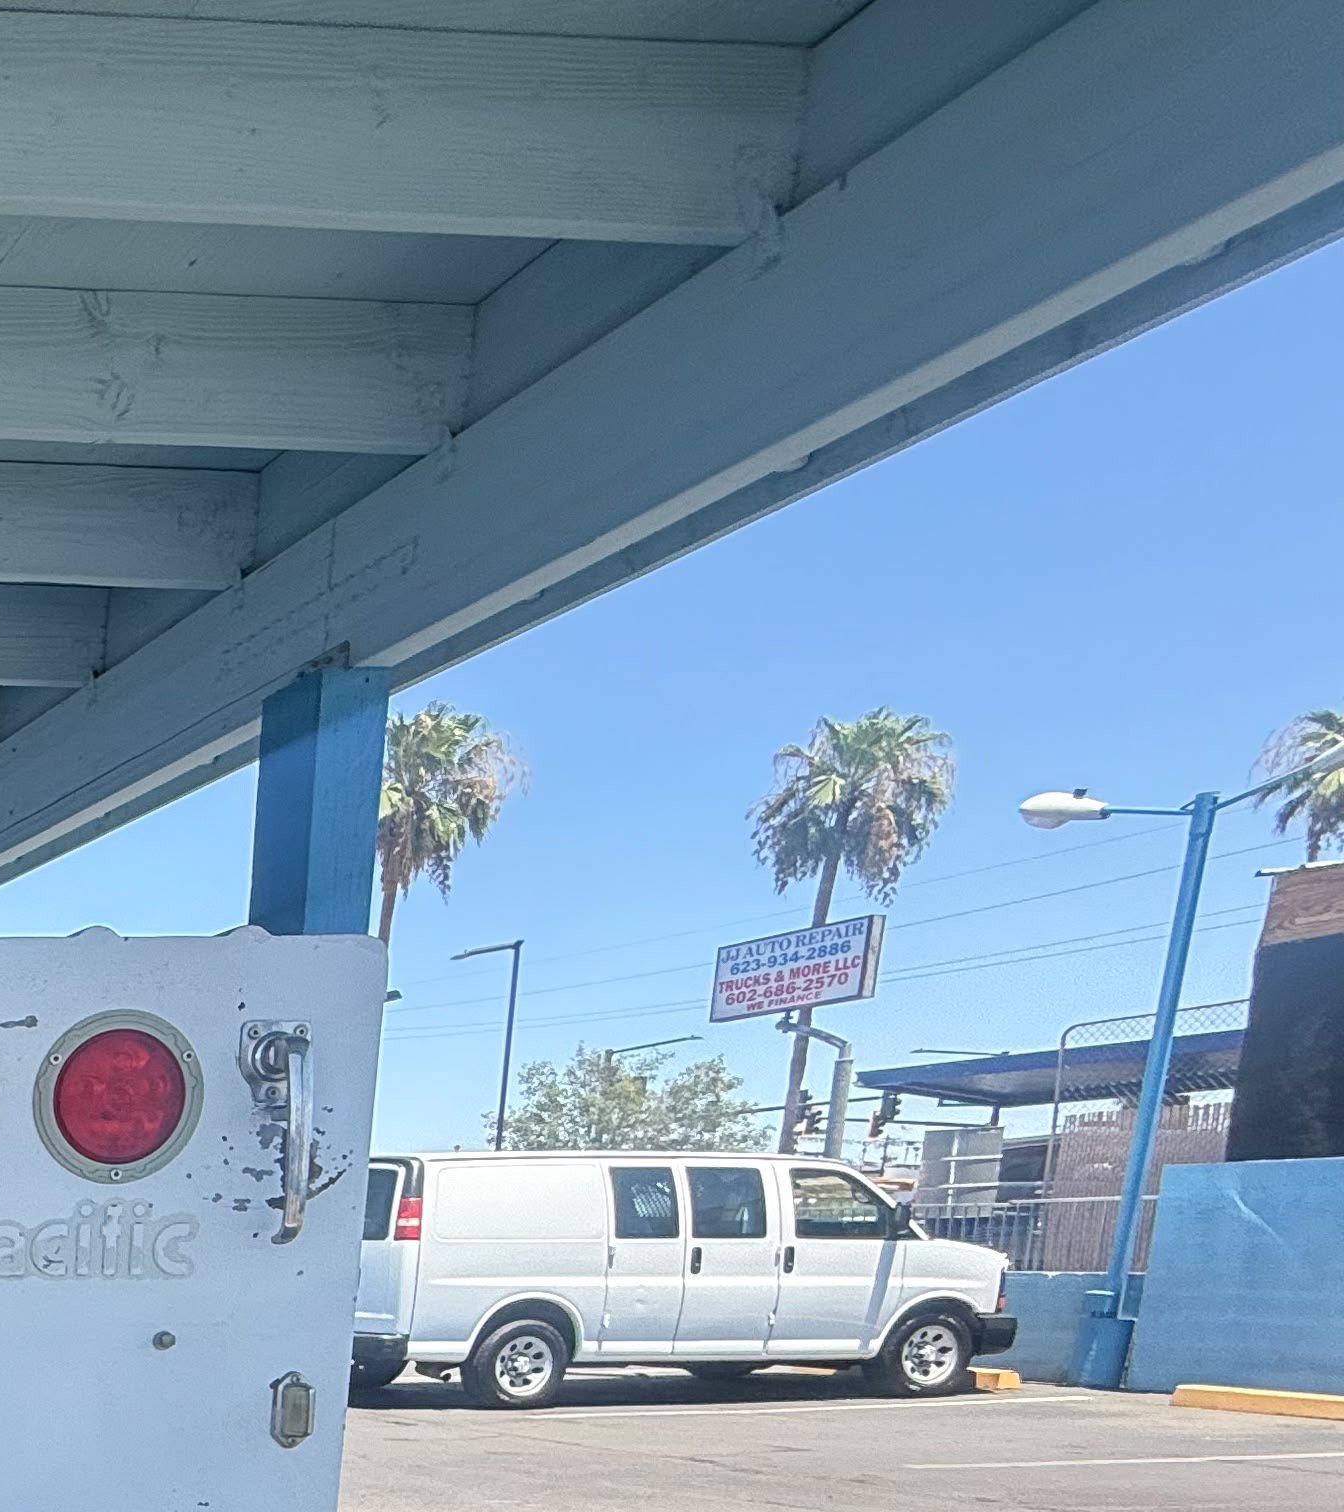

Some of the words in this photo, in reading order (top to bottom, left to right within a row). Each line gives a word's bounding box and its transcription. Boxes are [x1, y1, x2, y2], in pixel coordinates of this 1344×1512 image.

[721, 949, 741, 964] JJ
[743, 938, 792, 959] AUTO
[795, 922, 864, 948] REPAIR
[730, 940, 851, 975] 623-934-2886
[719, 973, 771, 994] TRUCKS
[774, 970, 785, 982] &
[789, 961, 831, 980] MORE
[834, 955, 861, 972] LLC
[726, 972, 849, 1006] 602-686-2570
[747, 1001, 764, 1011] WE
[768, 991, 823, 1008] FINANCE
